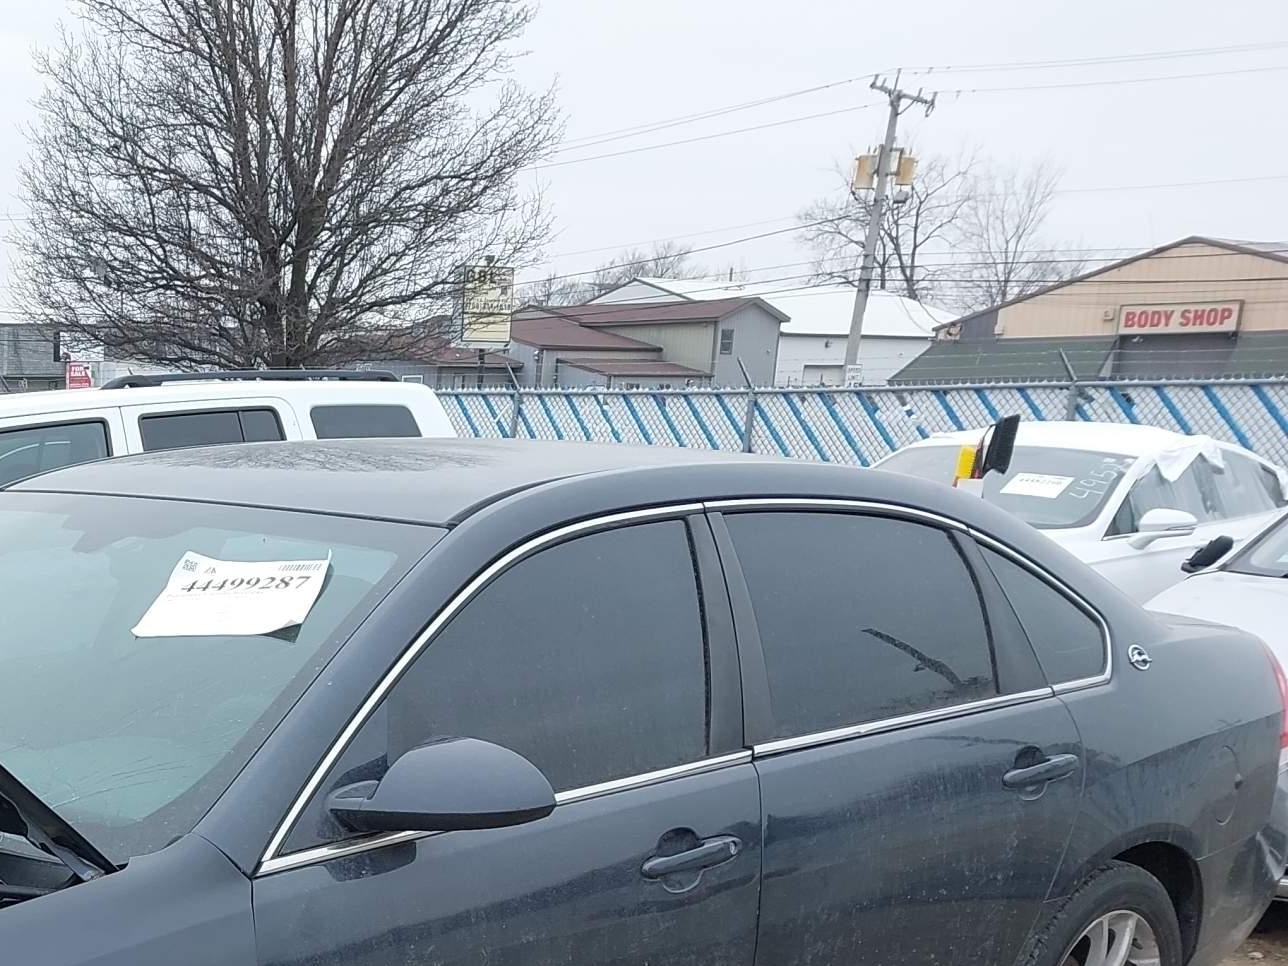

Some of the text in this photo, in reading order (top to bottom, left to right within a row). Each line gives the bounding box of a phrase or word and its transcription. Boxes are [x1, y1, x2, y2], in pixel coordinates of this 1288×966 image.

[1124, 307, 1233, 328] BODY SHOP
[180, 574, 312, 593] 44499287
